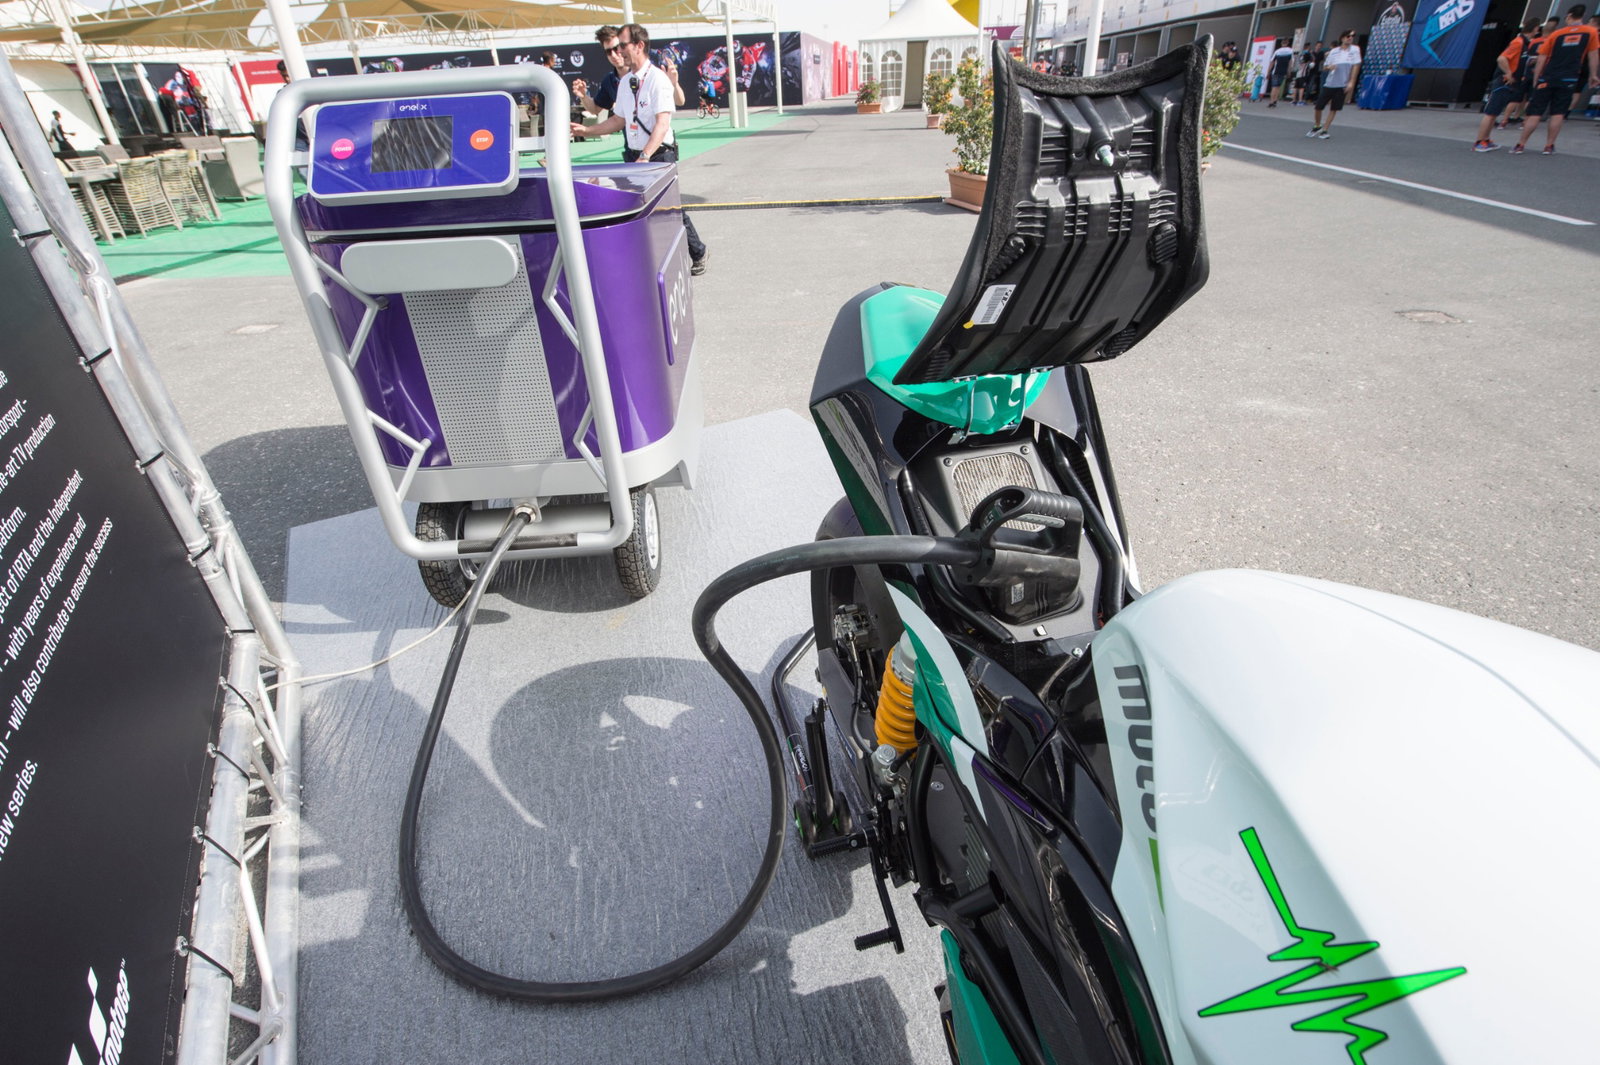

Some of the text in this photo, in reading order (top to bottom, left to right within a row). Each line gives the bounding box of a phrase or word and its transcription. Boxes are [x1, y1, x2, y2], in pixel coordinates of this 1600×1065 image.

[0, 399, 26, 440] orsport
[12, 442, 28, 465] TV
[23, 413, 56, 461] production
[48, 469, 84, 524] Independent
[29, 528, 46, 558] and
[39, 517, 55, 539] the
[6, 625, 28, 660] with
[22, 595, 45, 636] years
[40, 576, 52, 600] of
[46, 533, 78, 588] experience
[73, 512, 87, 539] and
[7, 568, 20, 594] of
[12, 548, 35, 581] IRTA
[8, 695, 28, 731] will
[21, 669, 41, 705] also
[36, 609, 70, 674] contribute
[63, 596, 76, 613] to
[70, 564, 92, 602] ensure
[84, 548, 99, 569] the
[93, 516, 114, 554] success
[8, 759, 39, 817] series.
